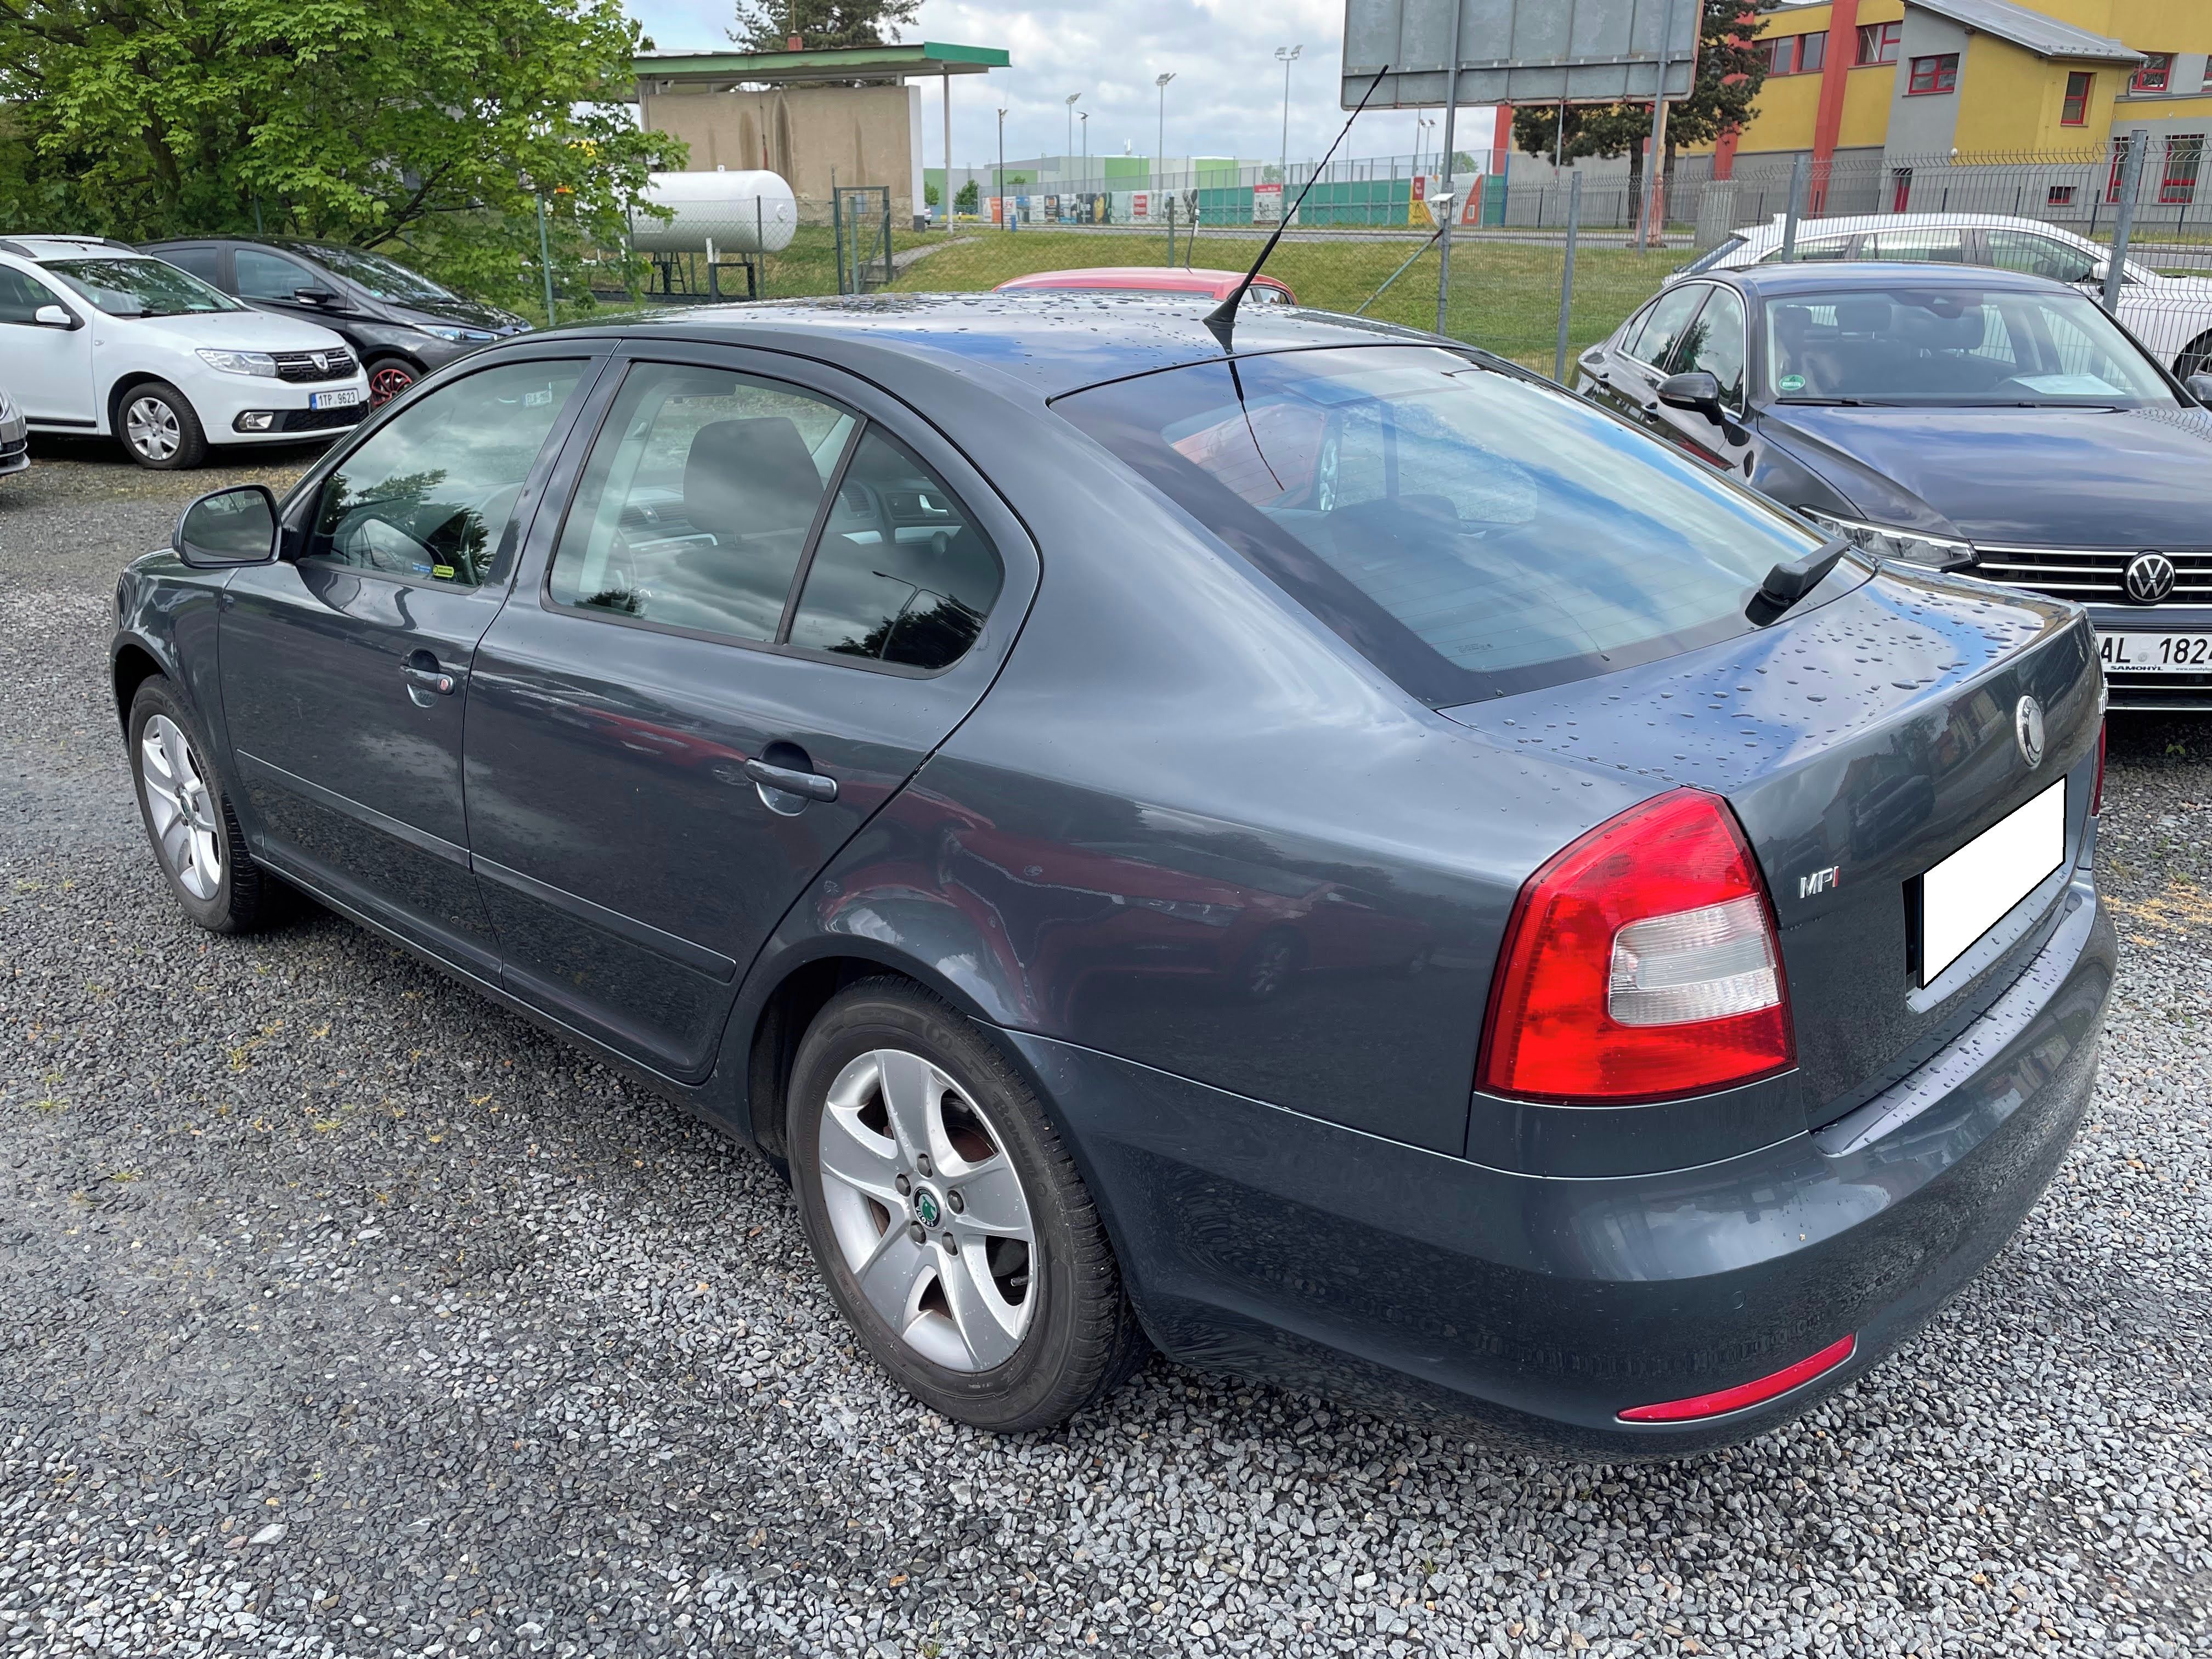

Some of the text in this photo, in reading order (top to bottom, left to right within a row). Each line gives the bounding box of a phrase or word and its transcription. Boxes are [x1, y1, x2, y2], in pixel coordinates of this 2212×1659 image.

[319, 392, 356, 406] 1TP 9623
[2159, 637, 2212, 664] 182
